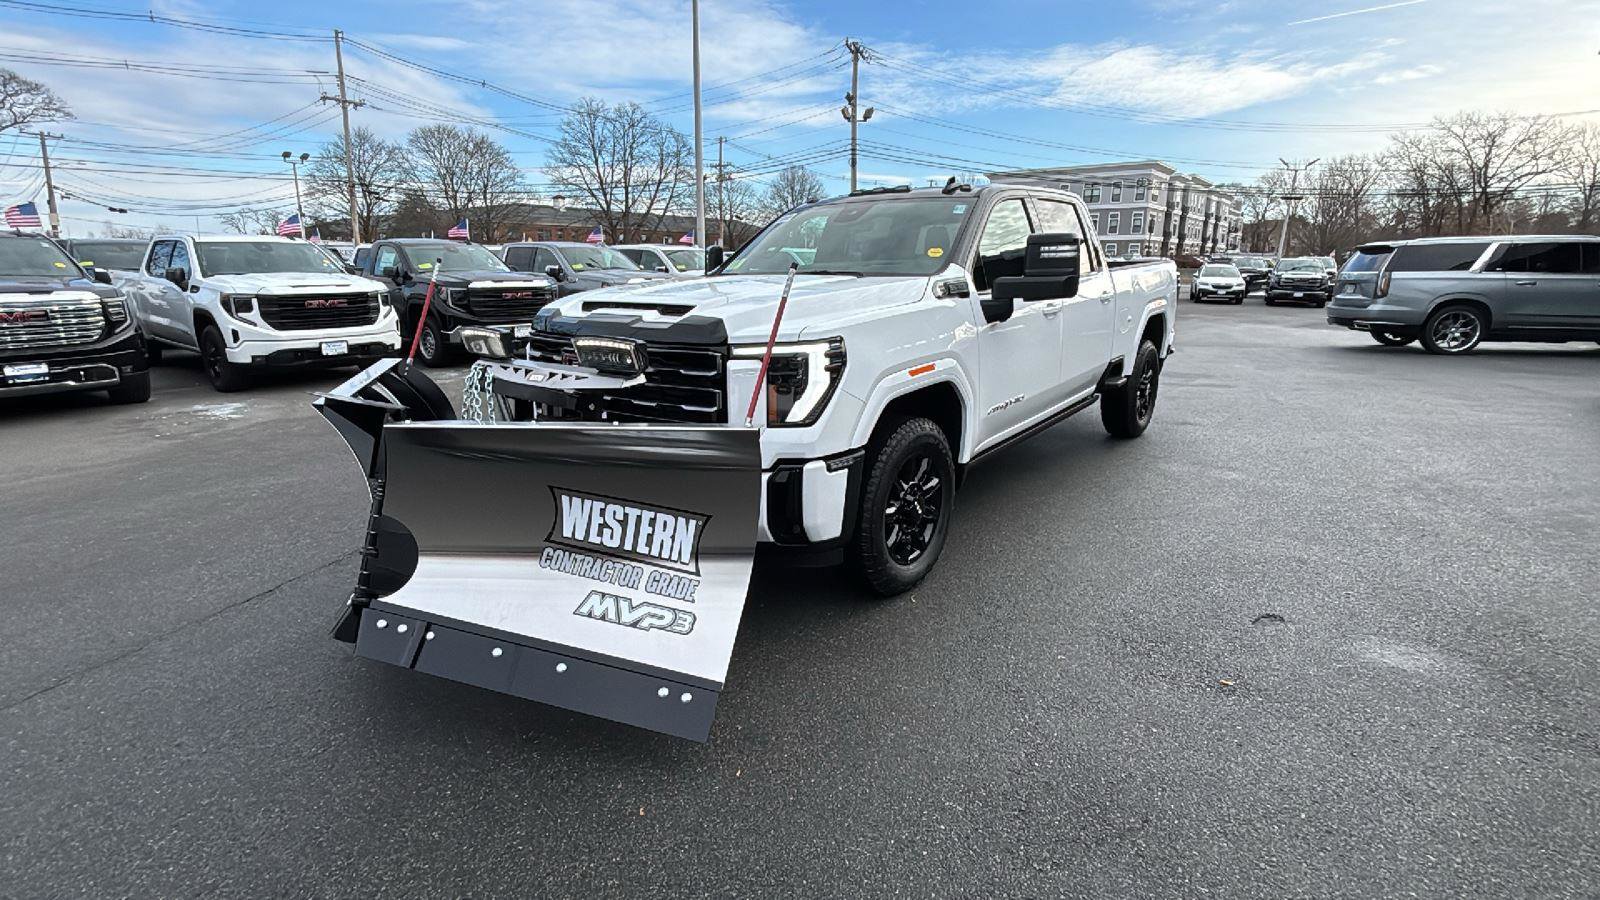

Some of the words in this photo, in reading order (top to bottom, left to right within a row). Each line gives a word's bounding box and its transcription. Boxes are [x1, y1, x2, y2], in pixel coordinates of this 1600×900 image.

[0, 311, 47, 323] MC
[304, 299, 348, 309] GMC
[560, 494, 697, 566] WESTERN
[539, 546, 644, 590] CONTRACTOR
[645, 569, 701, 604] GRADE
[573, 590, 697, 635] MVP3
